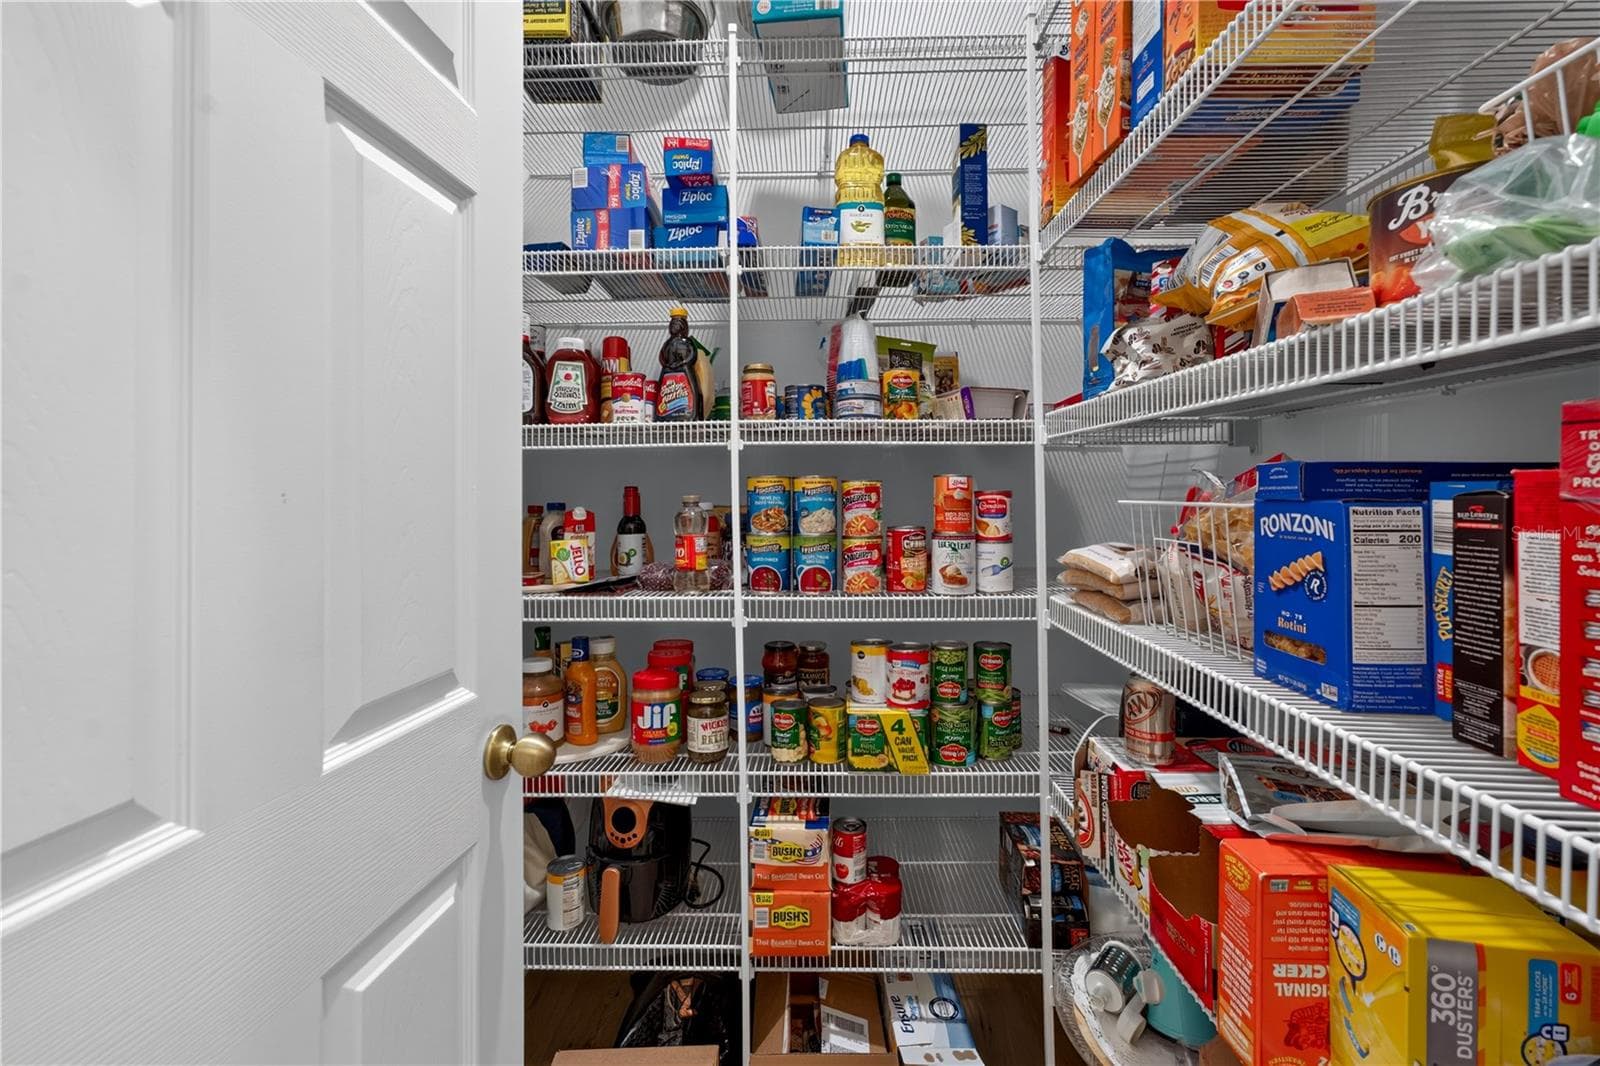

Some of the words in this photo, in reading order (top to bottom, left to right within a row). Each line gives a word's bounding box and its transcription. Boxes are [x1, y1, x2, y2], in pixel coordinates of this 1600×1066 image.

[681, 190, 713, 204] Ziploc
[668, 225, 703, 242] Ziploc
[1260, 512, 1335, 542] RONZONI
[1399, 535, 1421, 544] 200
[1277, 616, 1307, 634] Rotini
[637, 703, 677, 729] Jif
[891, 718, 906, 735] 4
[894, 736, 912, 746] CAN
[902, 754, 918, 762] PACK
[772, 846, 803, 858] BUSH'S
[773, 911, 809, 923] BUSH'S
[755, 938, 769, 946] That
[770, 938, 798, 947] Beautiful
[1273, 963, 1328, 978] CKER
[1273, 982, 1328, 997] IGINAL
[1565, 992, 1577, 1001] 6
[889, 995, 915, 1034] Ensure
[1457, 975, 1474, 1060] DUSTERS
